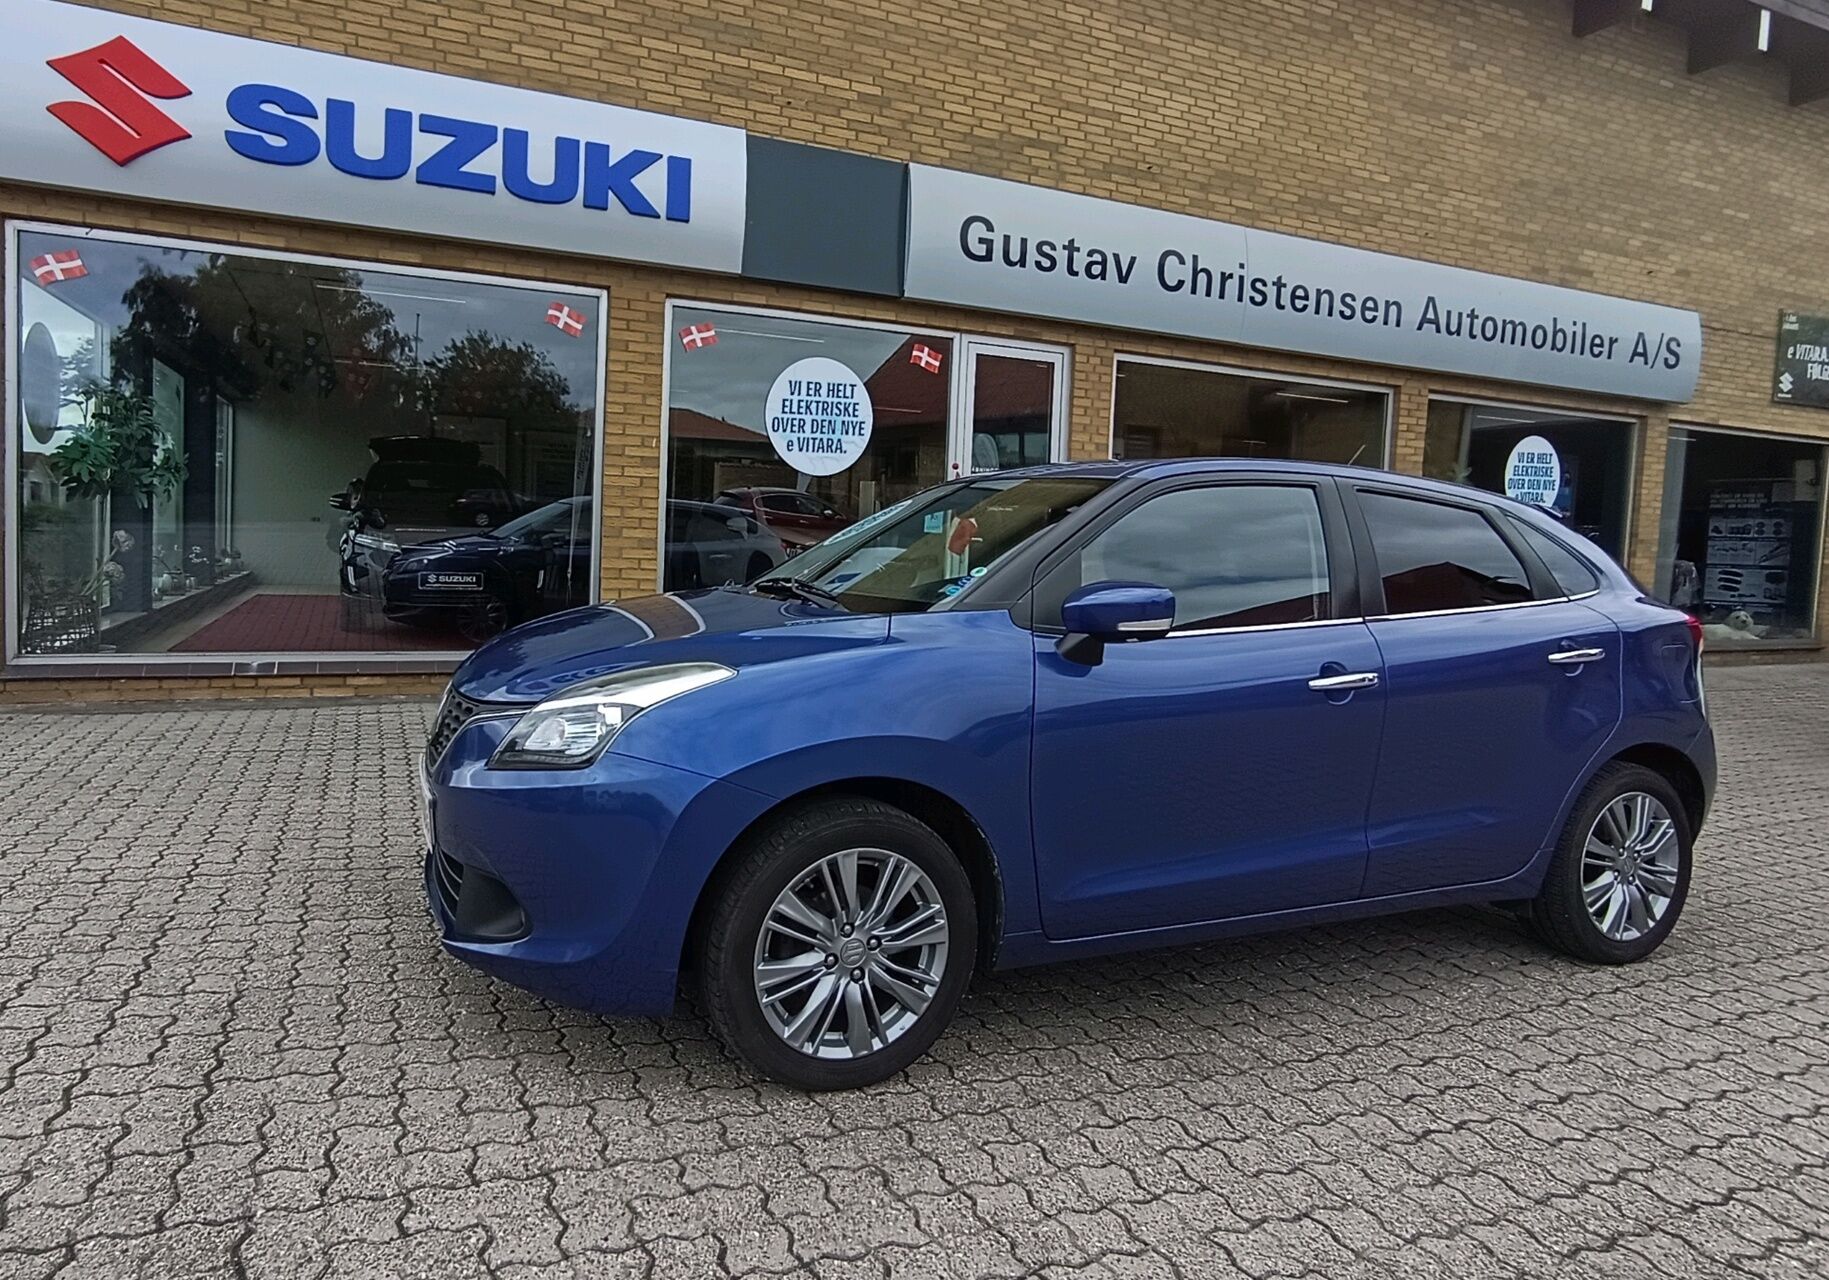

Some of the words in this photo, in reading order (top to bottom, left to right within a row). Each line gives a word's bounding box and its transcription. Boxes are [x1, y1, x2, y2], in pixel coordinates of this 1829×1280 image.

[225, 83, 692, 223] SUZUKI
[958, 215, 1138, 285] Gustav
[1156, 249, 1403, 328] Christensen
[1416, 296, 1619, 360] Automobiler
[1629, 331, 1682, 370] A/S
[788, 380, 802, 396] VI
[806, 381, 822, 398] ER
[826, 382, 857, 400] HELT
[781, 399, 860, 418] ELEKTRISKE
[771, 416, 806, 434] OVER
[810, 418, 837, 435] DEN
[840, 420, 866, 437] NYE
[786, 439, 794, 452] e
[797, 437, 848, 454] VITARA.
[1517, 452, 1525, 464] VI
[1526, 452, 1535, 464] ER
[1536, 453, 1553, 465] HELT
[1513, 465, 1554, 478] ELEKTRISKE
[1507, 477, 1526, 490] OVER
[1527, 479, 1541, 490] DEN
[1542, 479, 1557, 491] NYE
[438, 575, 476, 583] SUZUKI
